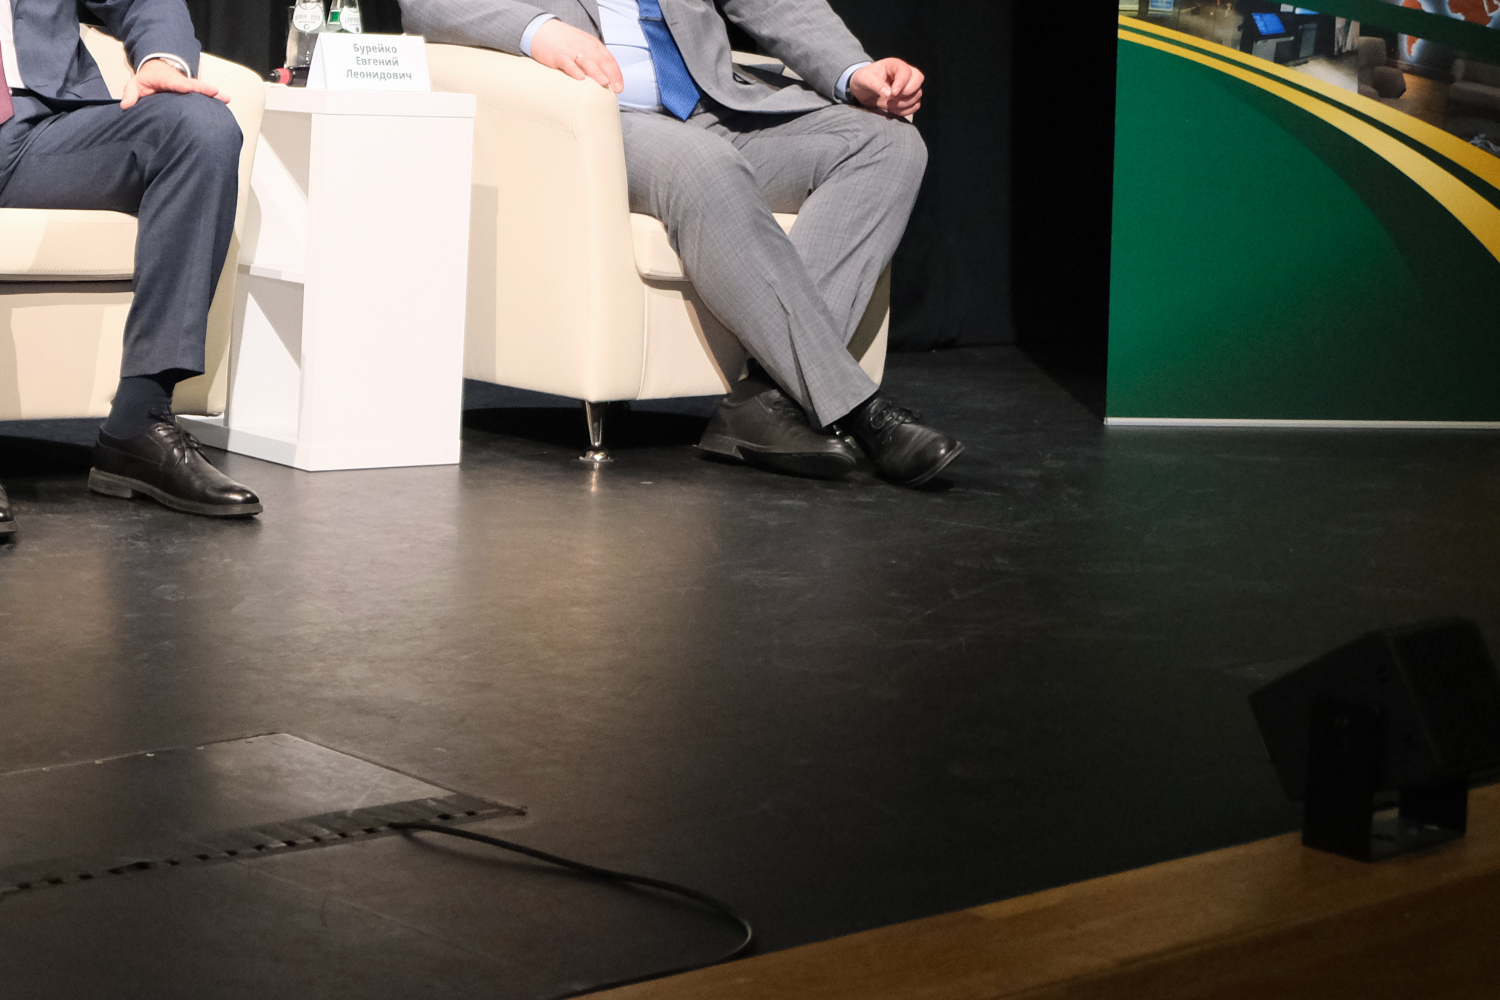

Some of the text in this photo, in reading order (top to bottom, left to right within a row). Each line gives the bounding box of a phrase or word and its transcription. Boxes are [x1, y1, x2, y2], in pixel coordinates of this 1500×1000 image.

[352, 43, 398, 56] Бурейко
[355, 56, 399, 67] Евгений
[345, 68, 412, 82] Леонидович
